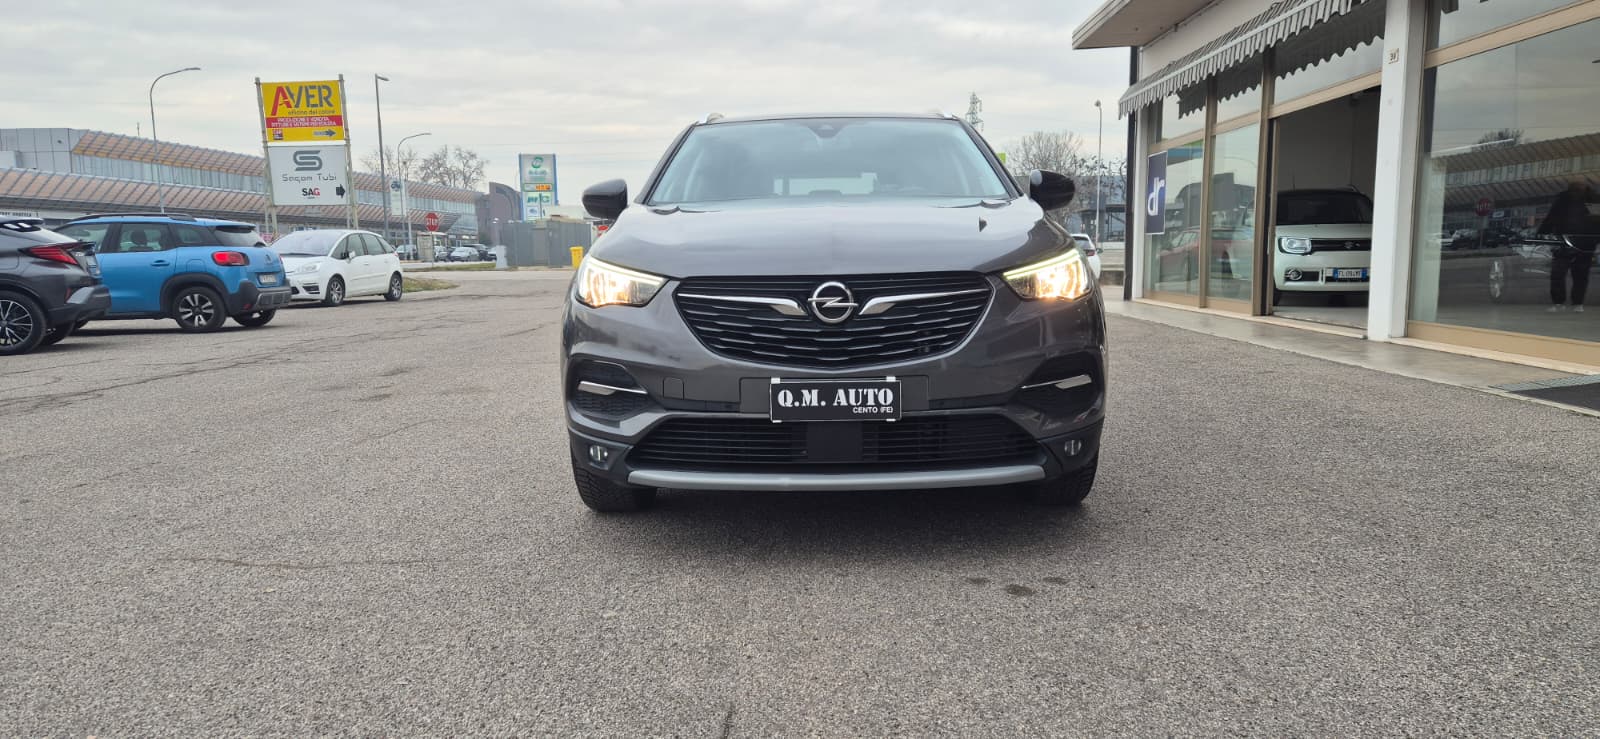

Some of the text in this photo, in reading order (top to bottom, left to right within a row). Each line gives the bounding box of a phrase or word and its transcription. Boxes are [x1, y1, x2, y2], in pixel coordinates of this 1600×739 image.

[271, 85, 333, 116] AVER
[302, 188, 320, 196] SAG
[1148, 177, 1165, 216] dr
[425, 217, 439, 226] STOP
[778, 388, 894, 407] Q.M. AUTO
